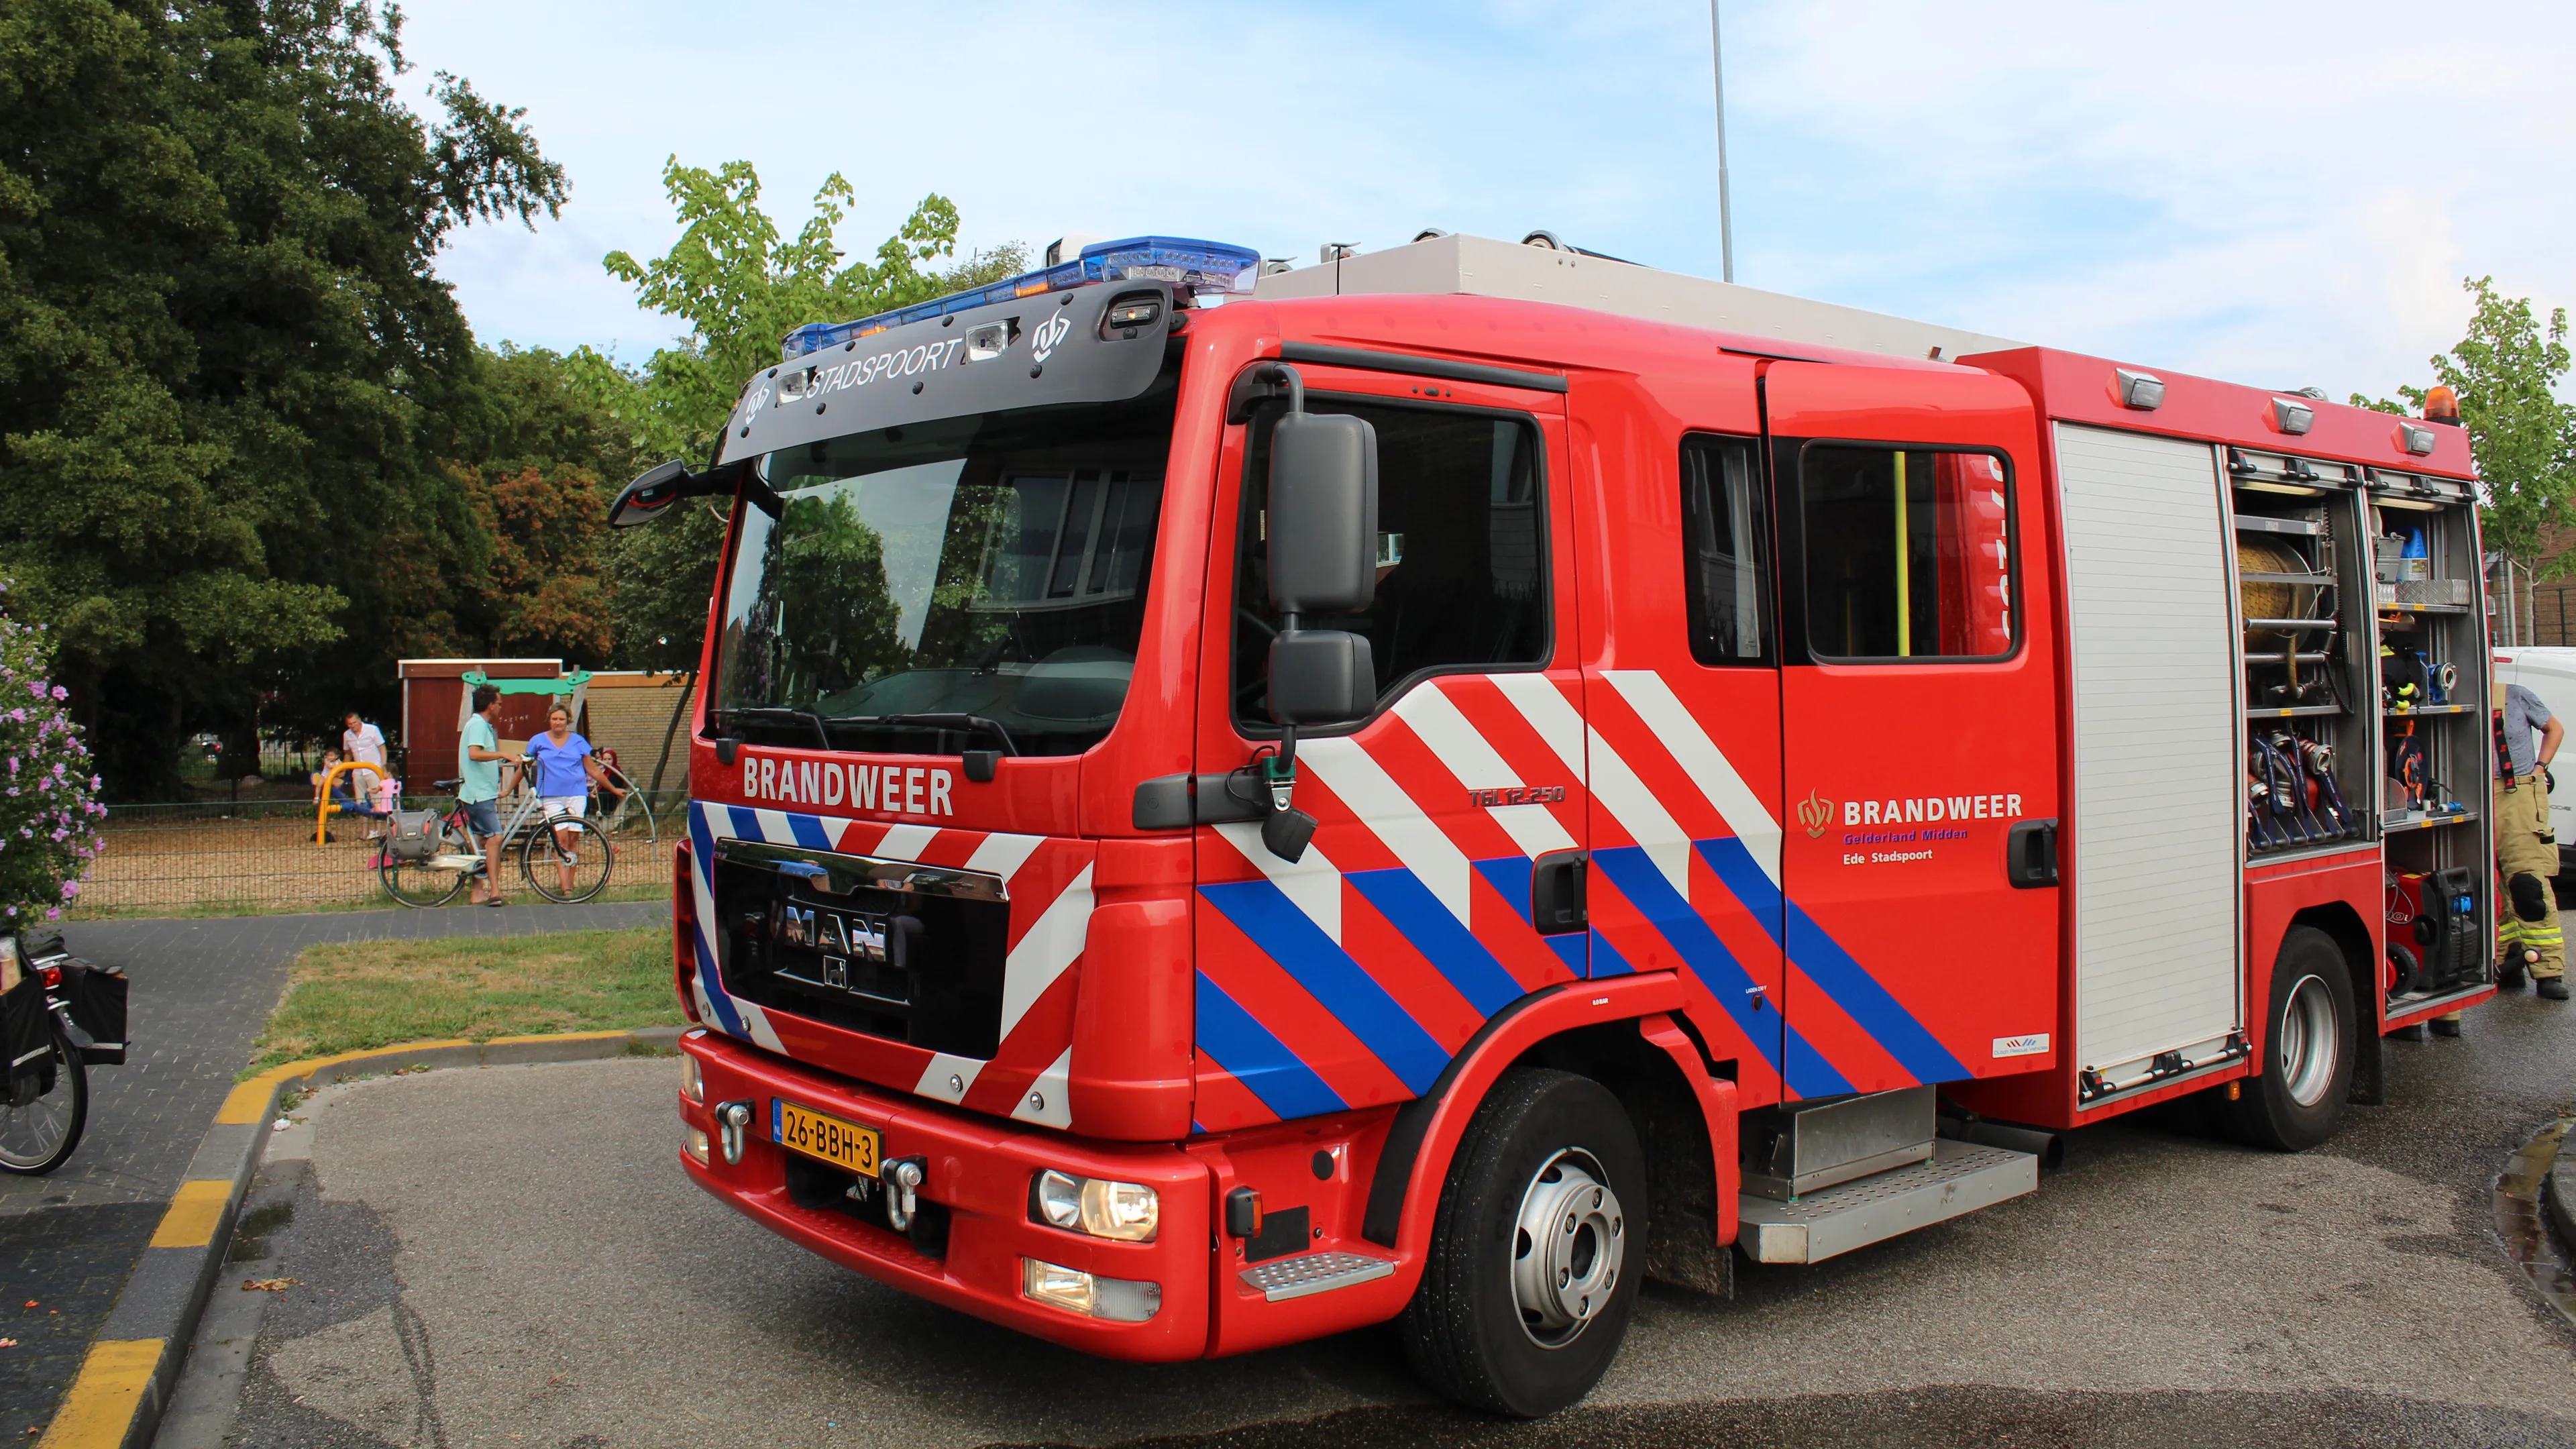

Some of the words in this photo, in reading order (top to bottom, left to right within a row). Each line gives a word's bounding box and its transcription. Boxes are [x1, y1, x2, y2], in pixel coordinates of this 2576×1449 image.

[806, 337, 963, 398] STADSPOORT
[744, 757, 953, 816] BRANDWEER
[1468, 790, 1502, 807] TGL
[1505, 786, 1565, 805] 12.250
[1844, 794, 2022, 826] BRANDWEER
[1843, 831, 1916, 845] Gelderland
[1921, 828, 1968, 841] Midden
[1843, 853, 1865, 865] Ede
[1872, 849, 1933, 863] Stadspoort
[786, 906, 885, 961] MAN
[774, 1125, 782, 1136] NL
[787, 1111, 873, 1169] 26-BBH-3
